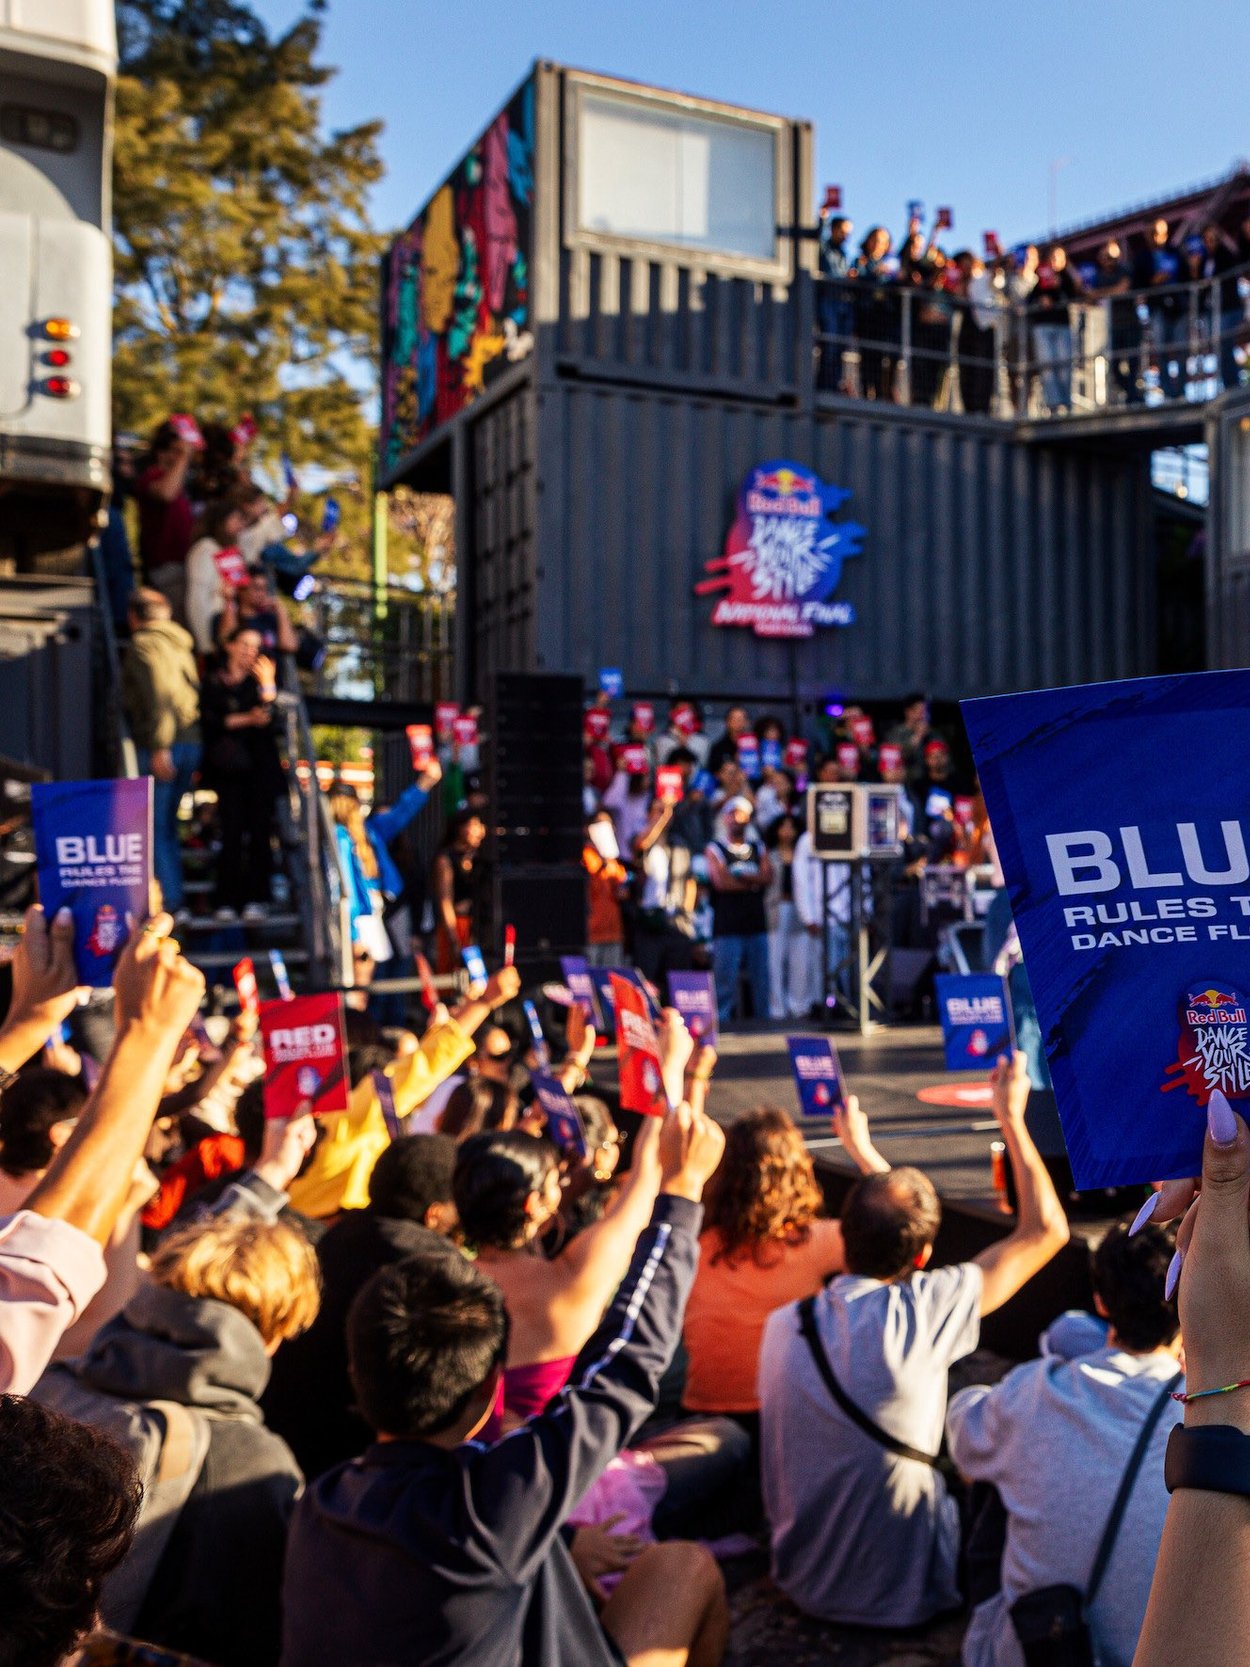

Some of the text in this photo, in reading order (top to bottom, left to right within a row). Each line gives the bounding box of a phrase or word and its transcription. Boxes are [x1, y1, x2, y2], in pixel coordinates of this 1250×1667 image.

[55, 833, 143, 865] BLUE
[1063, 897, 1217, 927] RULES
[1071, 926, 1197, 951] DANCE
[1186, 1008, 1247, 1025] Red Bull
[1193, 1025, 1248, 1053] DANCE
